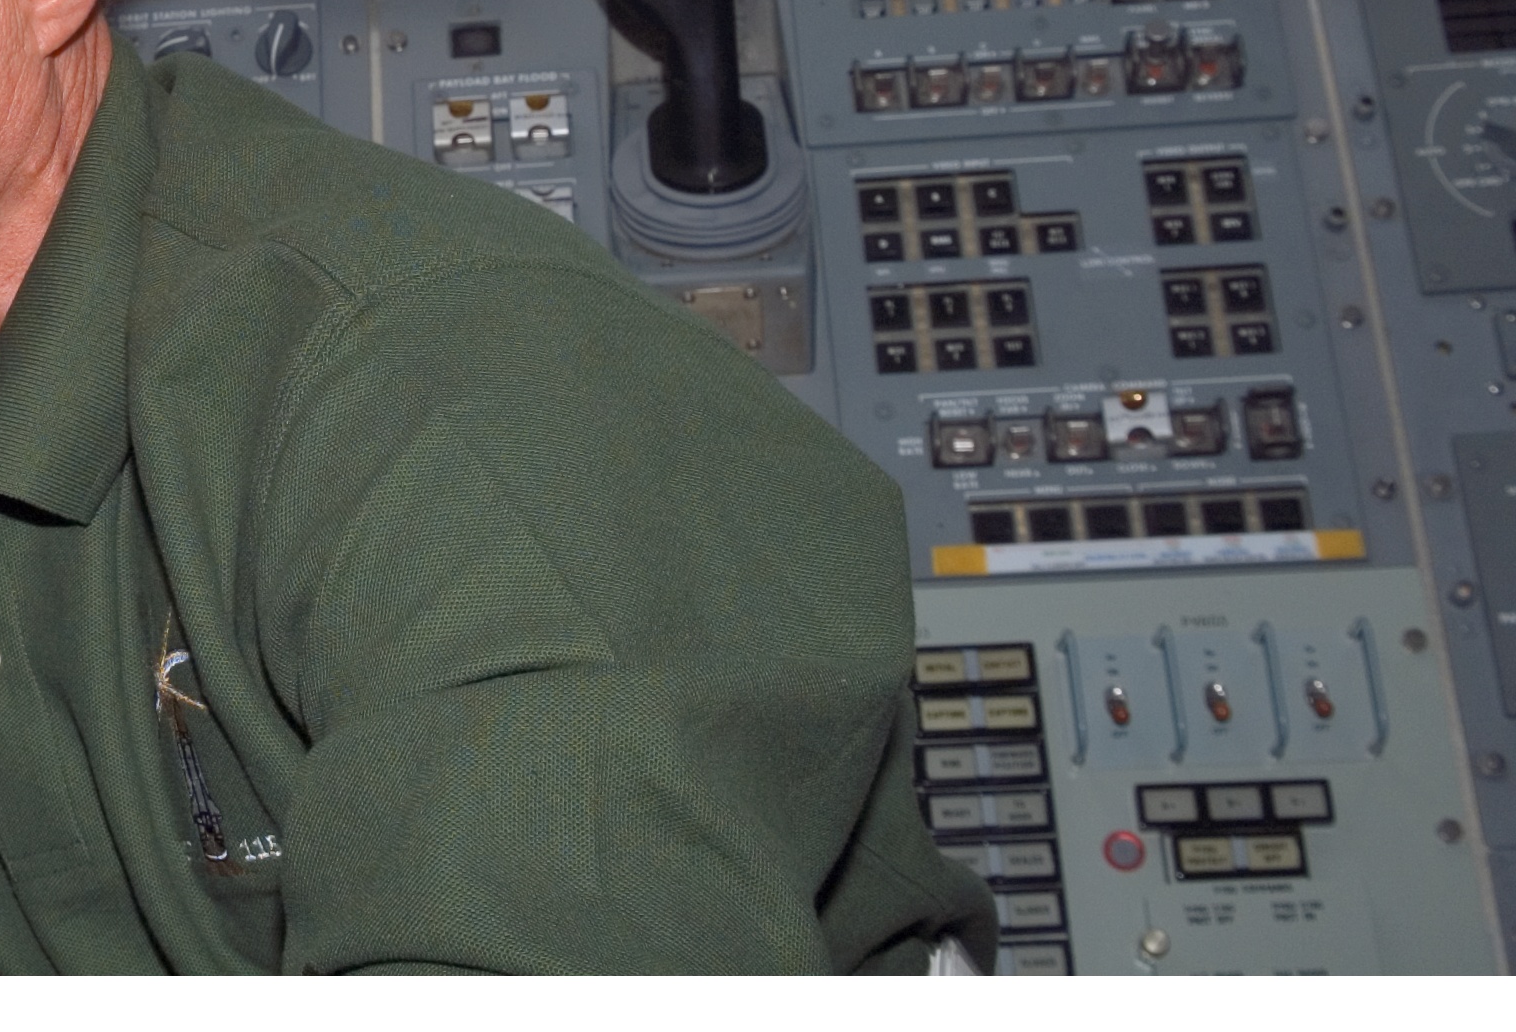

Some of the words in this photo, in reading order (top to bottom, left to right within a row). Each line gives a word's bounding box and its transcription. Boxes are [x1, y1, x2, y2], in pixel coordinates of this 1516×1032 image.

[438, 75, 491, 88] PAYLOAD
[493, 74, 516, 86] BAY
[518, 71, 558, 83] FLOOD
